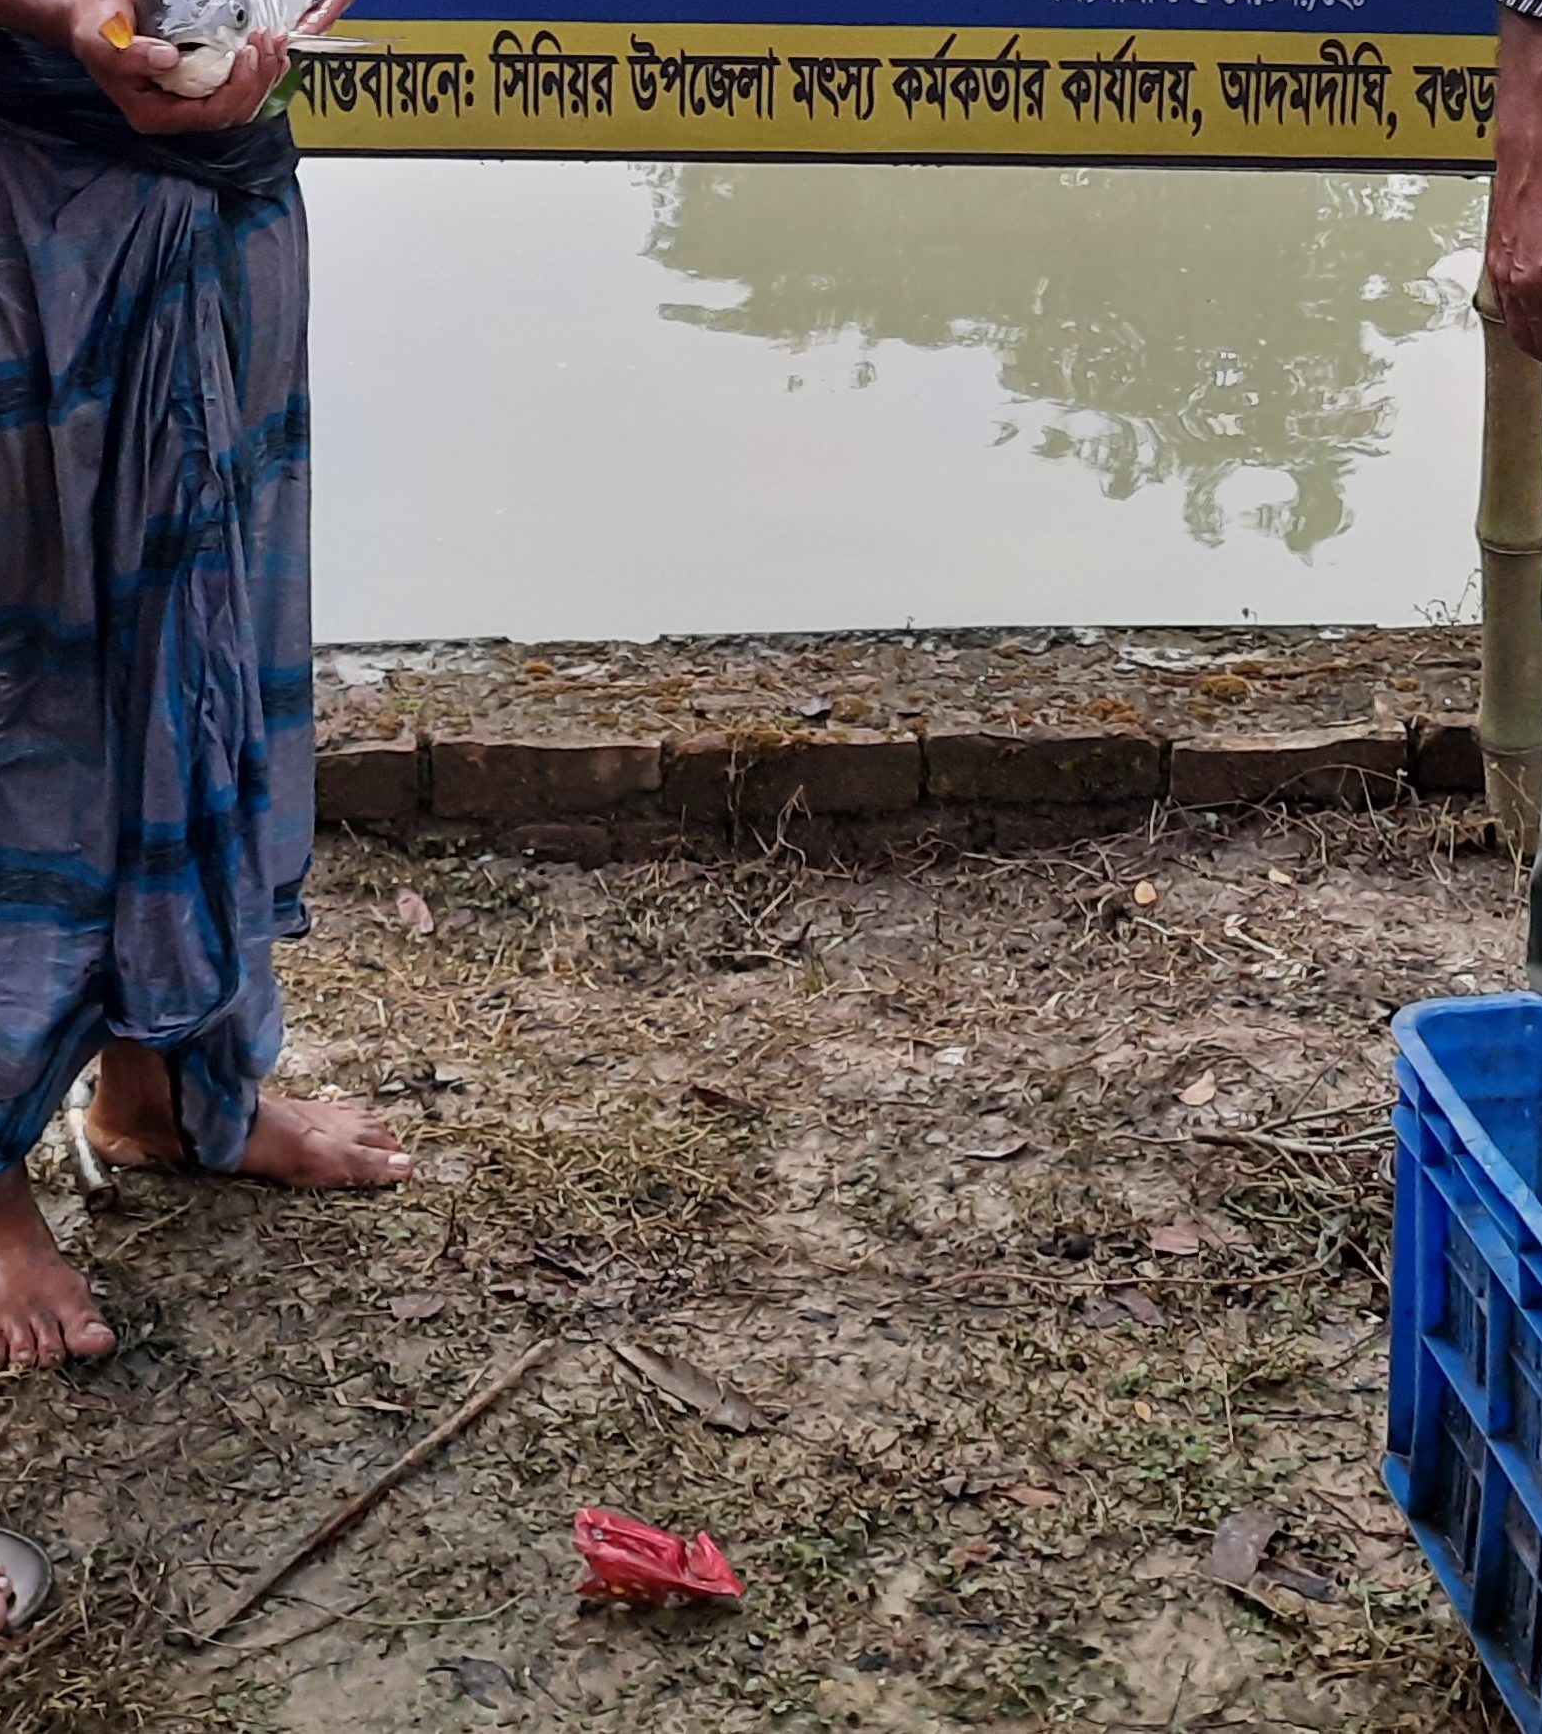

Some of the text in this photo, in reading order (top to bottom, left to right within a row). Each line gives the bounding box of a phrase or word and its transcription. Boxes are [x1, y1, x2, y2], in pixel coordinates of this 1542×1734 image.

[488, 29, 620, 119] সিনিয়র
[626, 32, 782, 120] উপজেলা
[787, 56, 883, 121] মৎস্য
[888, 33, 1051, 123] কর্মকর্তার
[1058, 35, 1202, 137] কার্যালয়,
[1216, 38, 1396, 140] আদমদীঘি,
[1413, 64, 1497, 140] বগুড়
